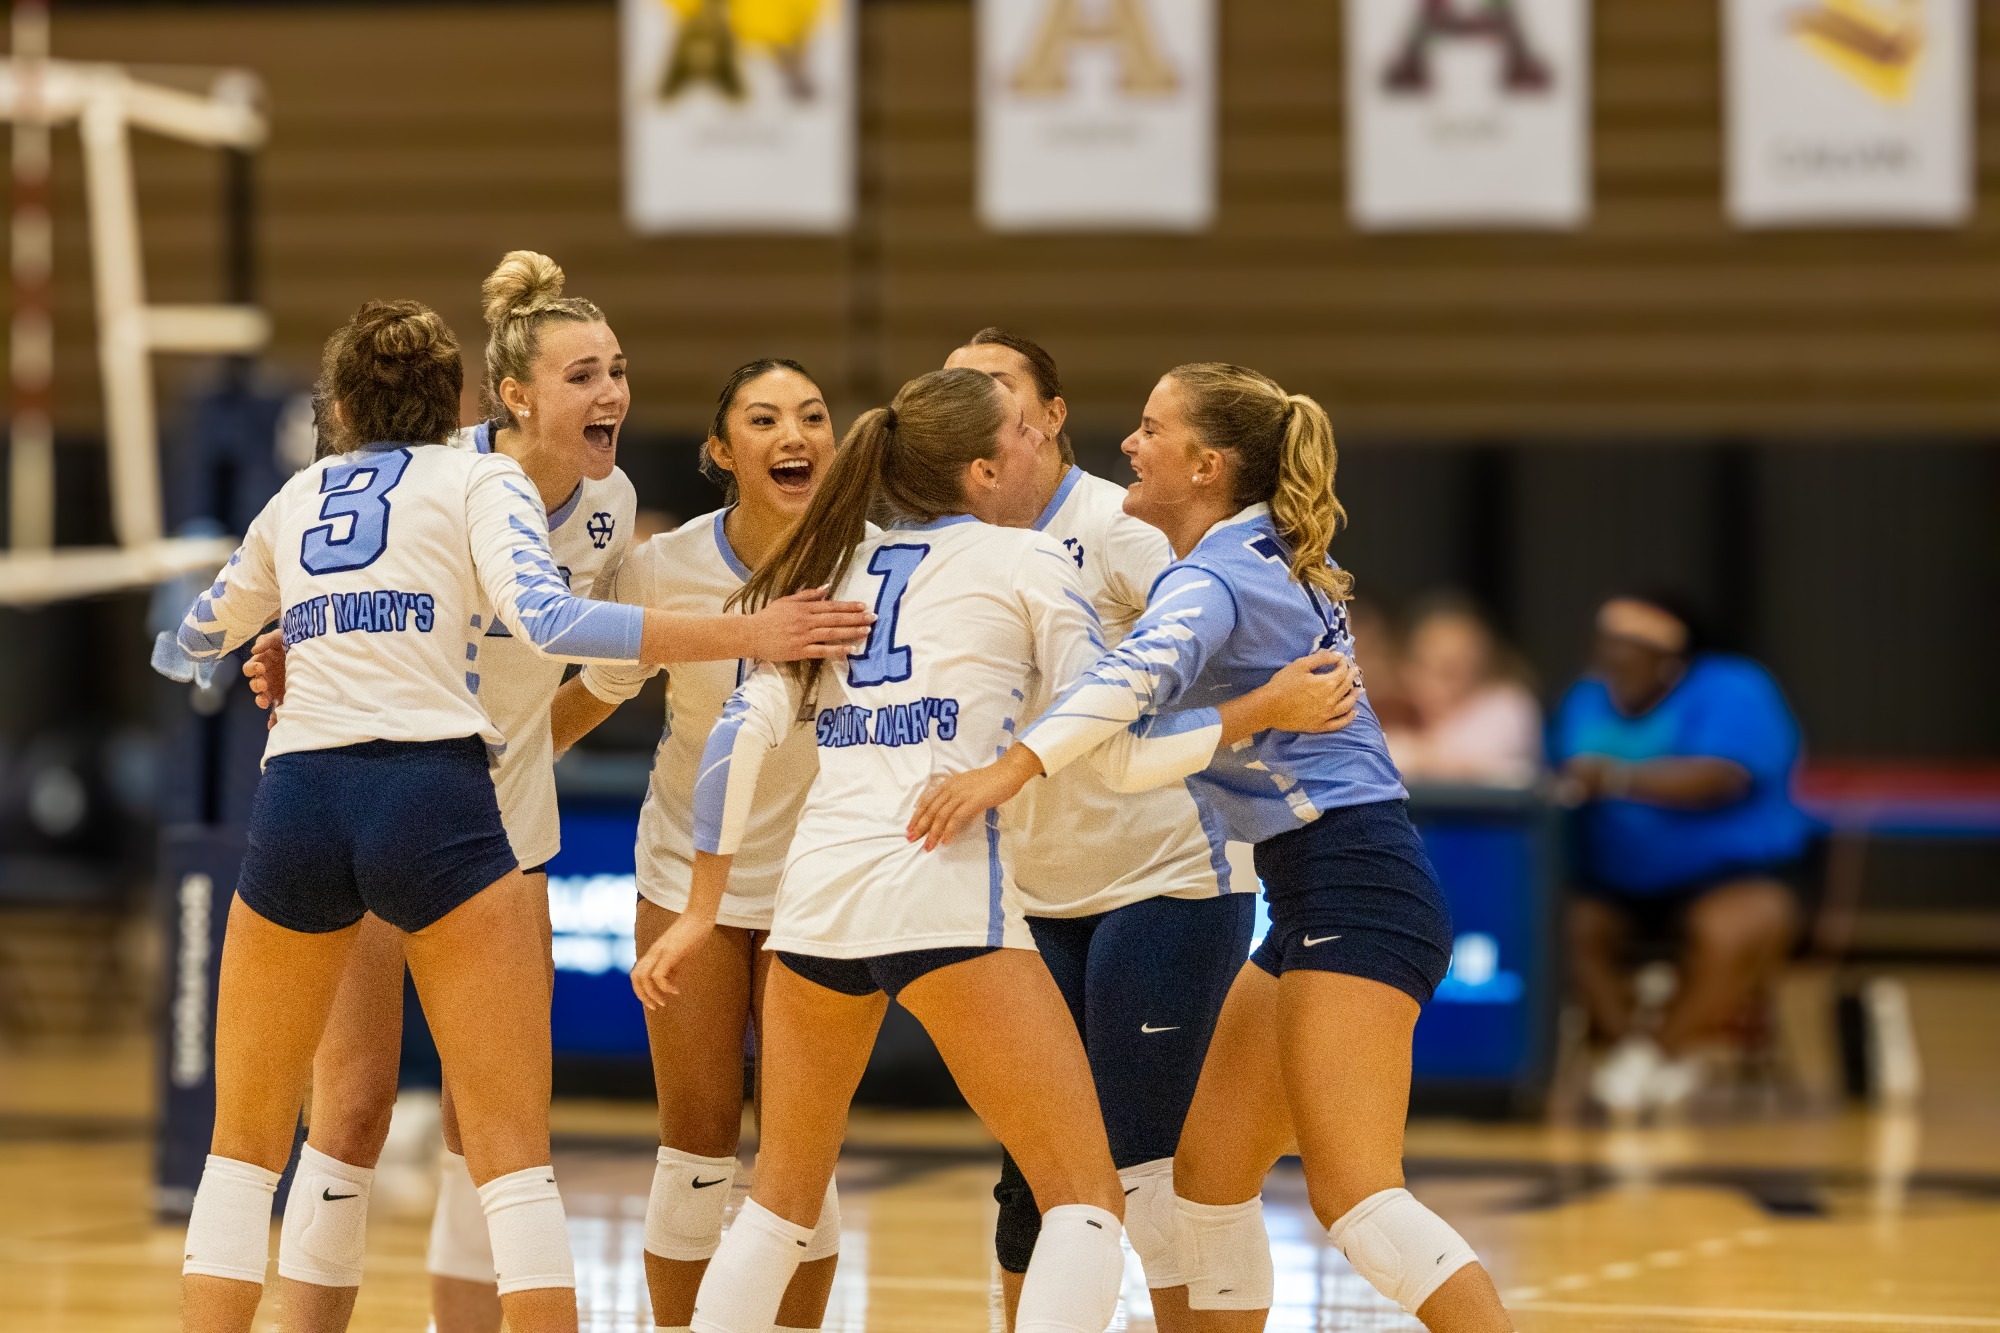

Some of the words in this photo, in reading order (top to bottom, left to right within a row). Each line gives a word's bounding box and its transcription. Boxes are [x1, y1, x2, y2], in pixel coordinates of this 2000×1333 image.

[1007, 0, 1179, 98] A
[1380, 0, 1557, 95] A
[300, 447, 413, 576] 3
[331, 589, 435, 634] MARY'S
[846, 543, 931, 688] 1
